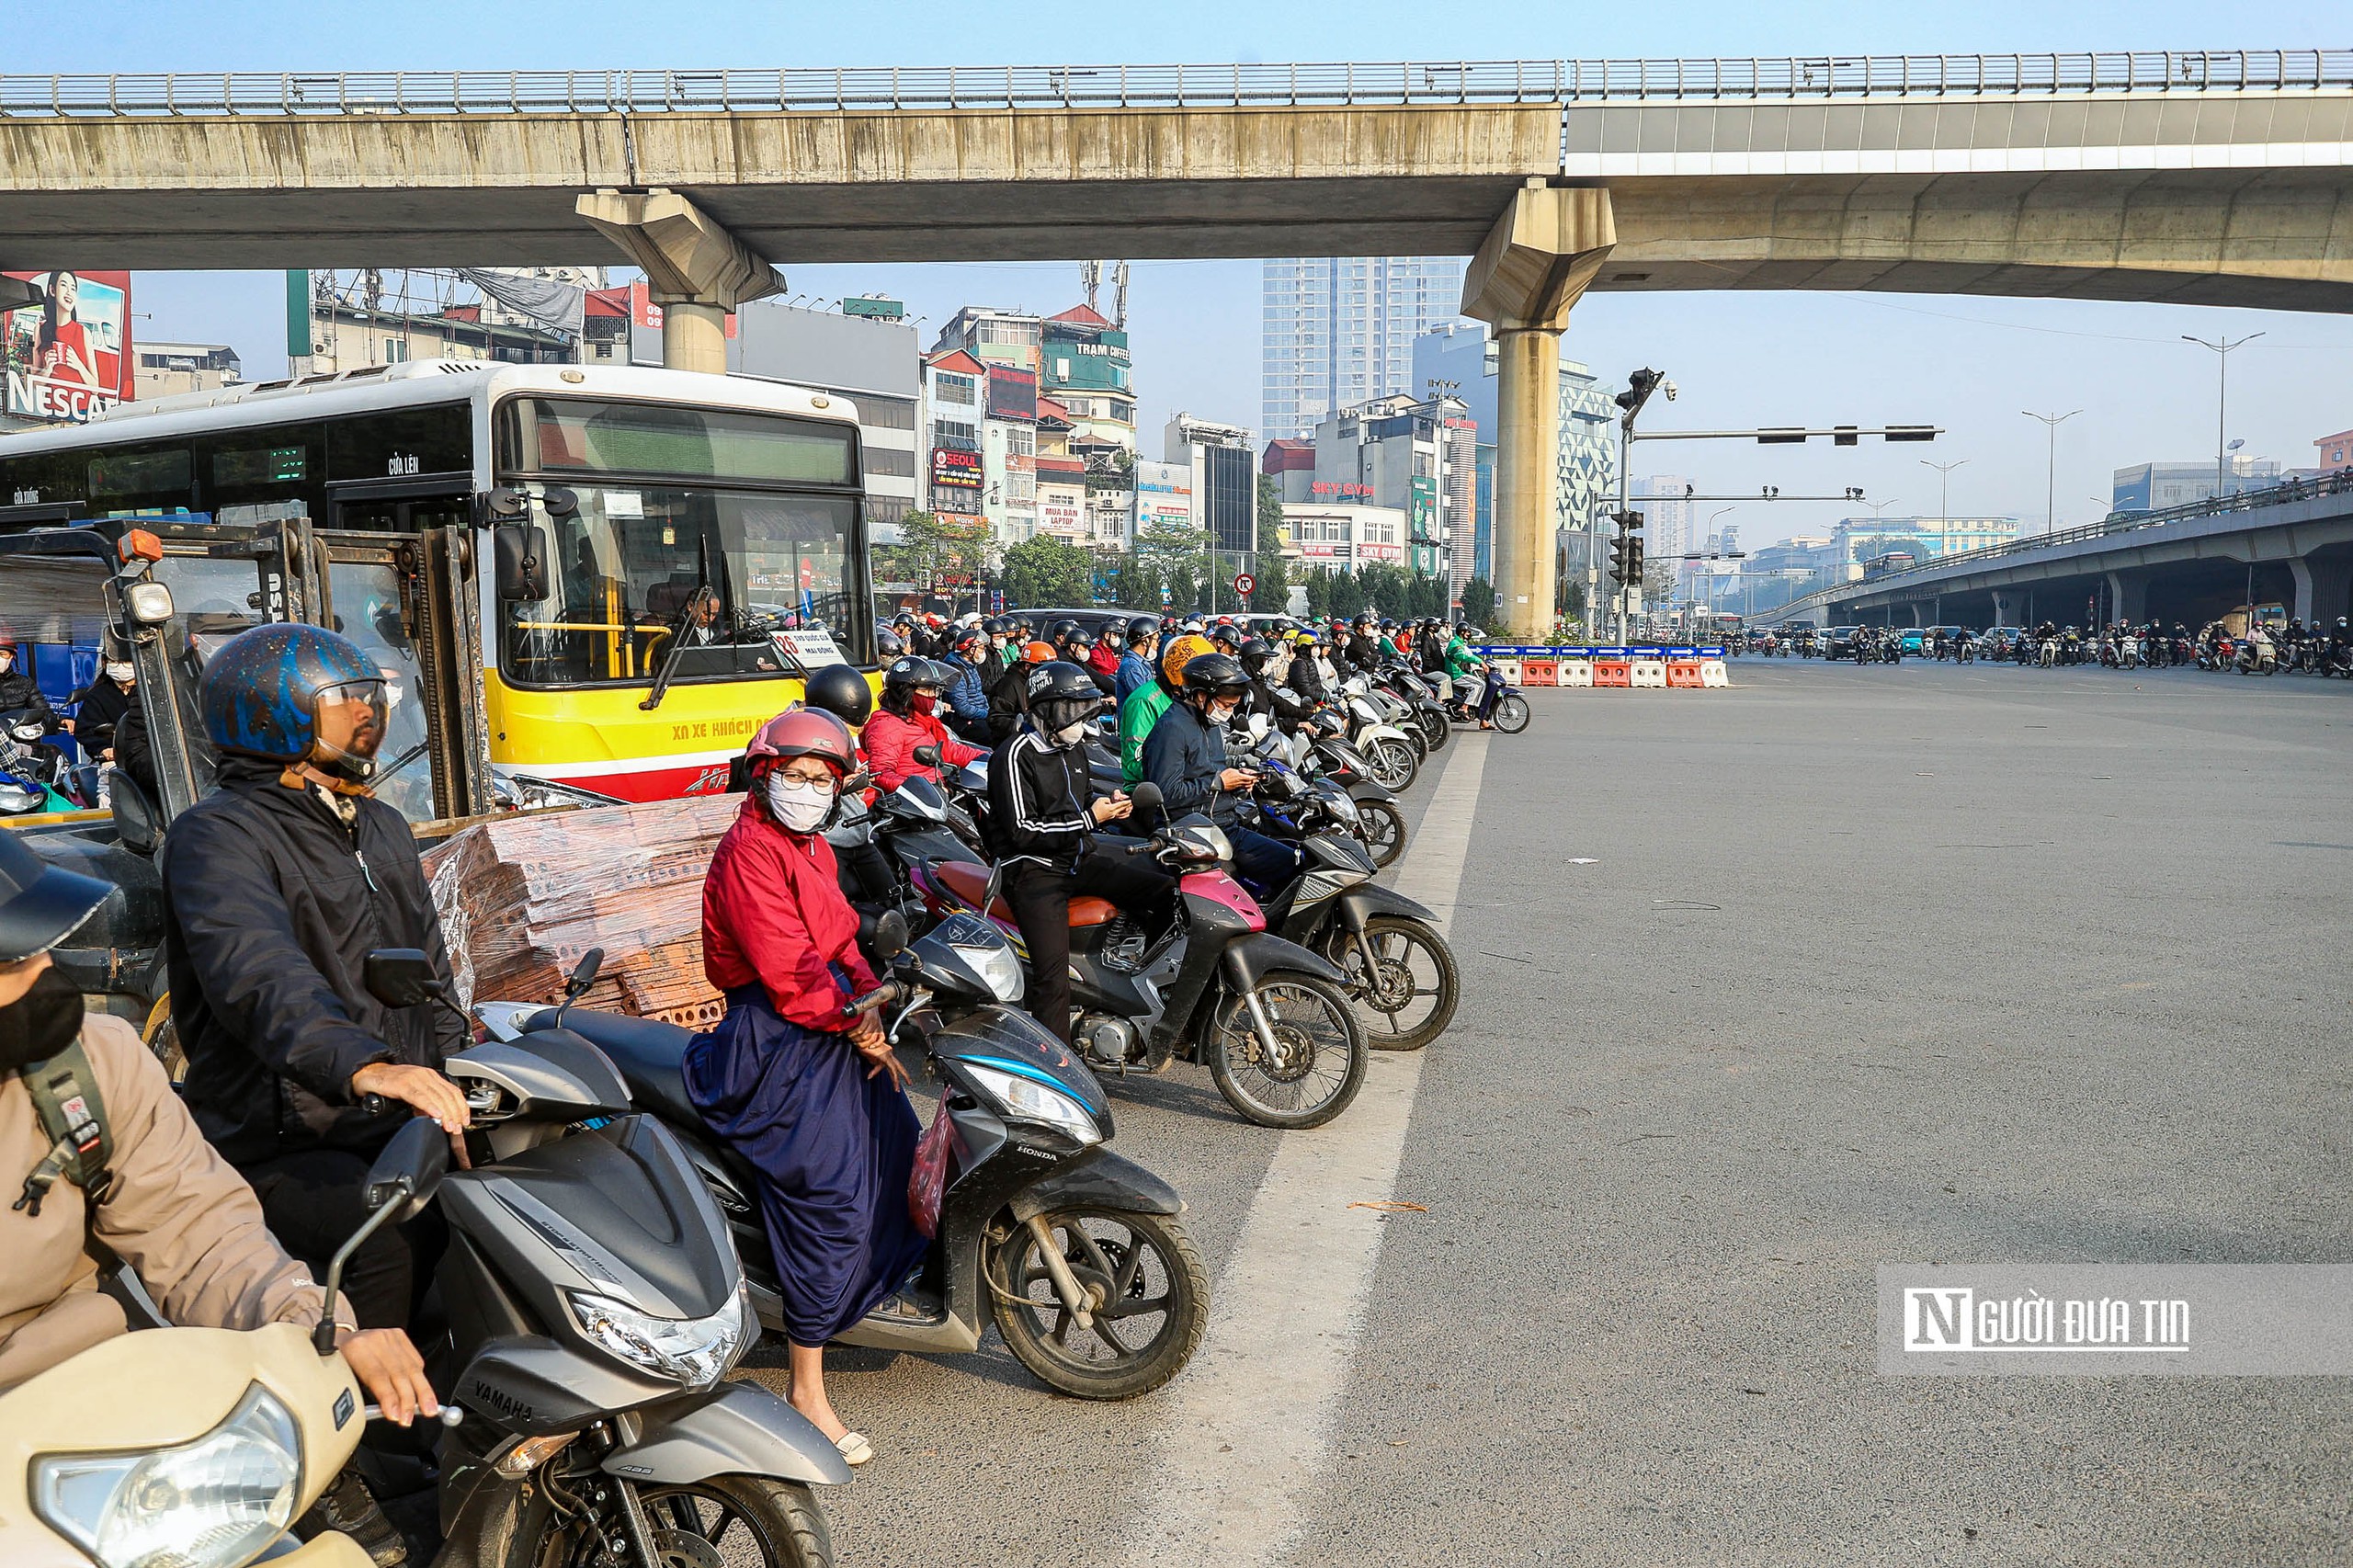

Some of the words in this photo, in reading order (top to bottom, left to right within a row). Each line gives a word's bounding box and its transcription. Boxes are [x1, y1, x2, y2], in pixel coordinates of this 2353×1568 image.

[1076, 343, 1108, 358] TRẠM
[1109, 345, 1130, 360] COFFEE
[404, 454, 419, 474] LÊN
[946, 453, 978, 467] SEOUL
[1312, 482, 1339, 494] SKY
[1343, 483, 1375, 496] GYM
[1051, 517, 1074, 525] LAPTOP
[1361, 546, 1380, 557] SKY
[1381, 548, 1401, 559] GYM
[777, 635, 799, 653] 26
[692, 723, 707, 738] XE
[712, 718, 753, 737] KHÁCH
[1306, 876, 1333, 892] HONDA
[1017, 1145, 1058, 1162] HONDA
[474, 1380, 533, 1423] YAMAHA
